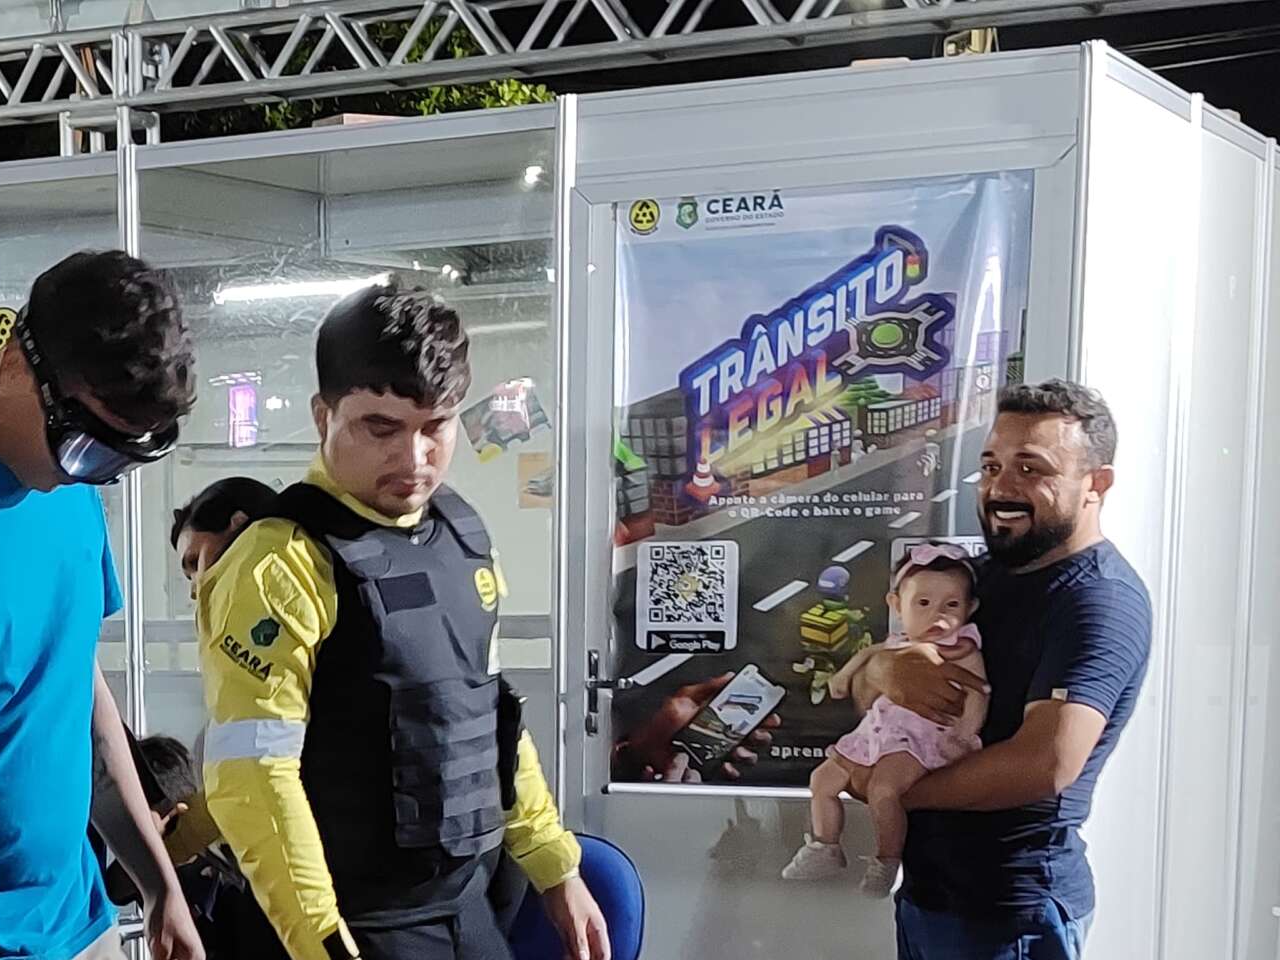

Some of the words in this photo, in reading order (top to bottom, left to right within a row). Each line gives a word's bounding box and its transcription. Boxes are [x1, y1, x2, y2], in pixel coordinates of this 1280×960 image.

[706, 189, 784, 214] CEARÁ
[692, 248, 904, 417] TRÂNSITO
[700, 352, 842, 462] LEGAL
[708, 494, 755, 506] Aponte
[843, 491, 889, 502] celular
[223, 635, 275, 679] CEARÁ
